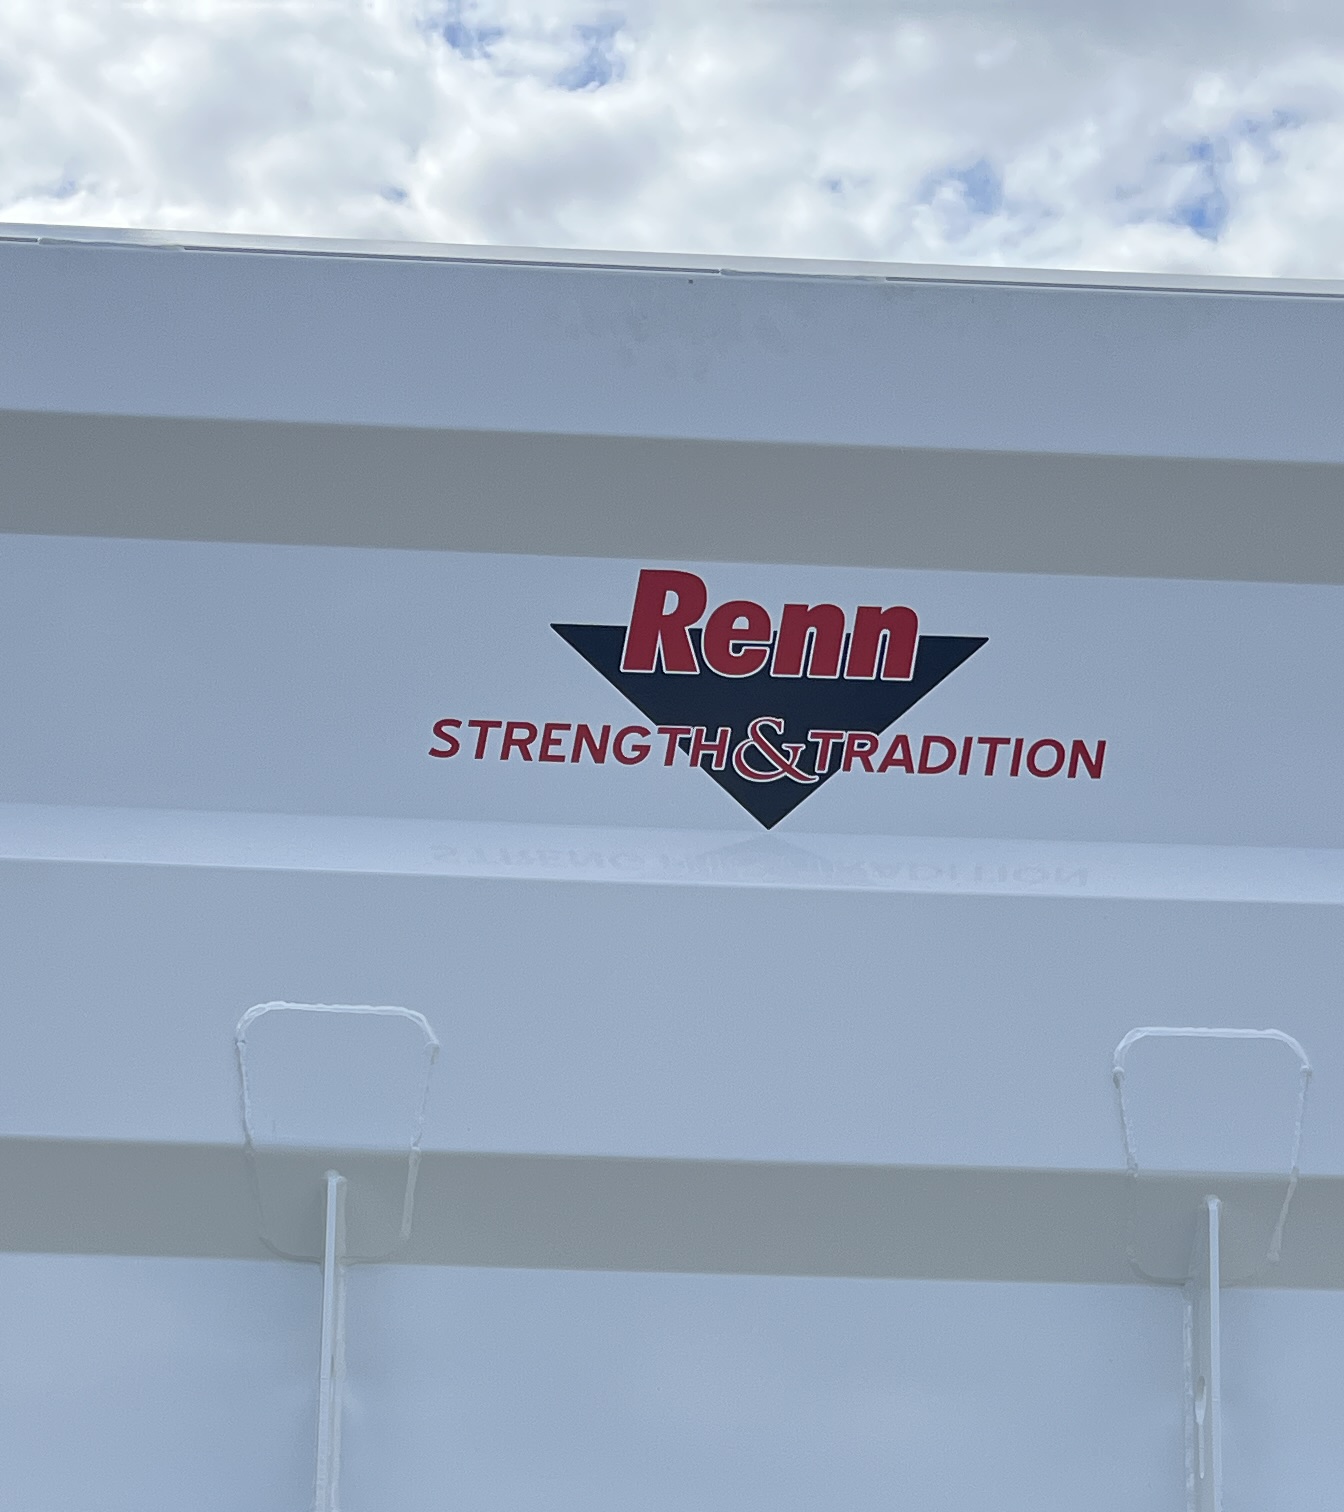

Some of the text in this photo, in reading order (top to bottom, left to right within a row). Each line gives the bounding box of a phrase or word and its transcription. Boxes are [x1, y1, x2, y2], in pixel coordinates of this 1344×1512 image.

[620, 568, 920, 681] Renn
[428, 716, 1106, 783] STRENGTH & TRADITION
